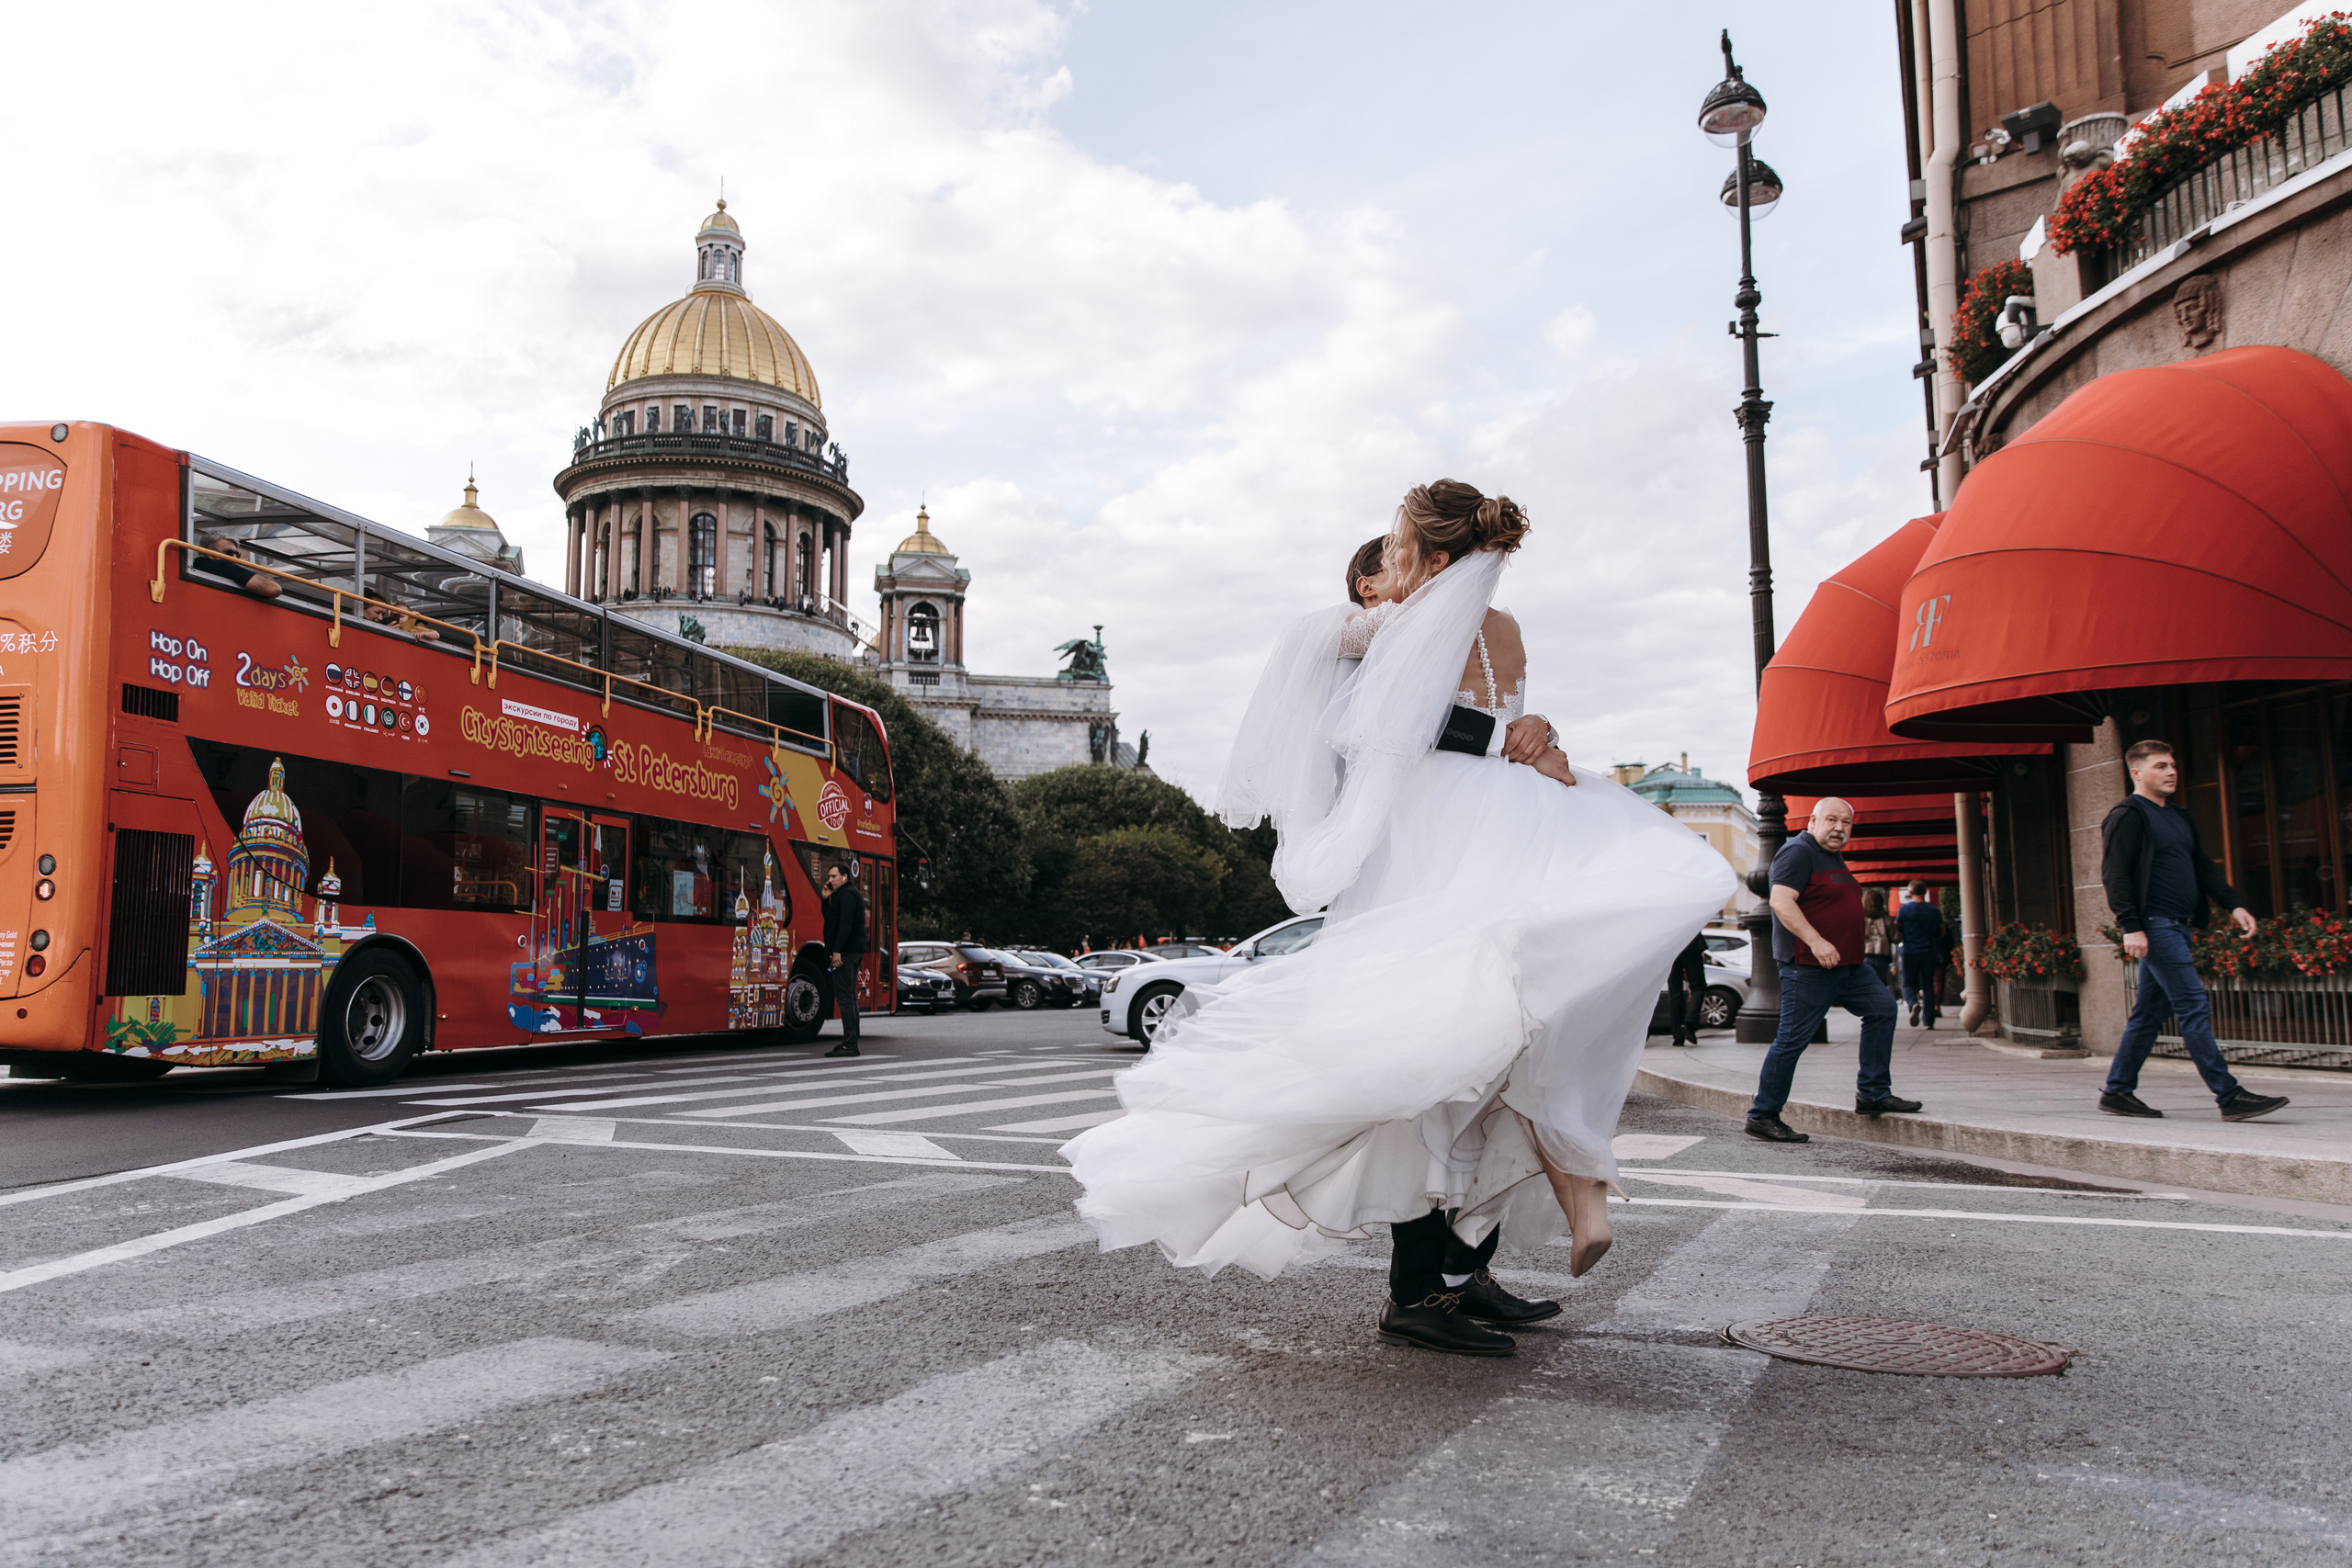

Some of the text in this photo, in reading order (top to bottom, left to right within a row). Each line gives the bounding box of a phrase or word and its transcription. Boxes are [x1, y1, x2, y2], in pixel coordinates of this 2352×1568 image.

[0, 469, 62, 492] PING
[150, 630, 209, 662] Hop On
[1917, 649, 1961, 664] ASTORIA
[150, 657, 211, 688] Hop Off
[236, 687, 300, 716] Valid Ticket
[503, 703, 578, 728] экскурсии по городу
[613, 739, 739, 810] St Petersburg
[820, 798, 850, 818] OFFICIAL
[830, 815, 843, 827] TOUR
[6, 931, 17, 939] Gold
